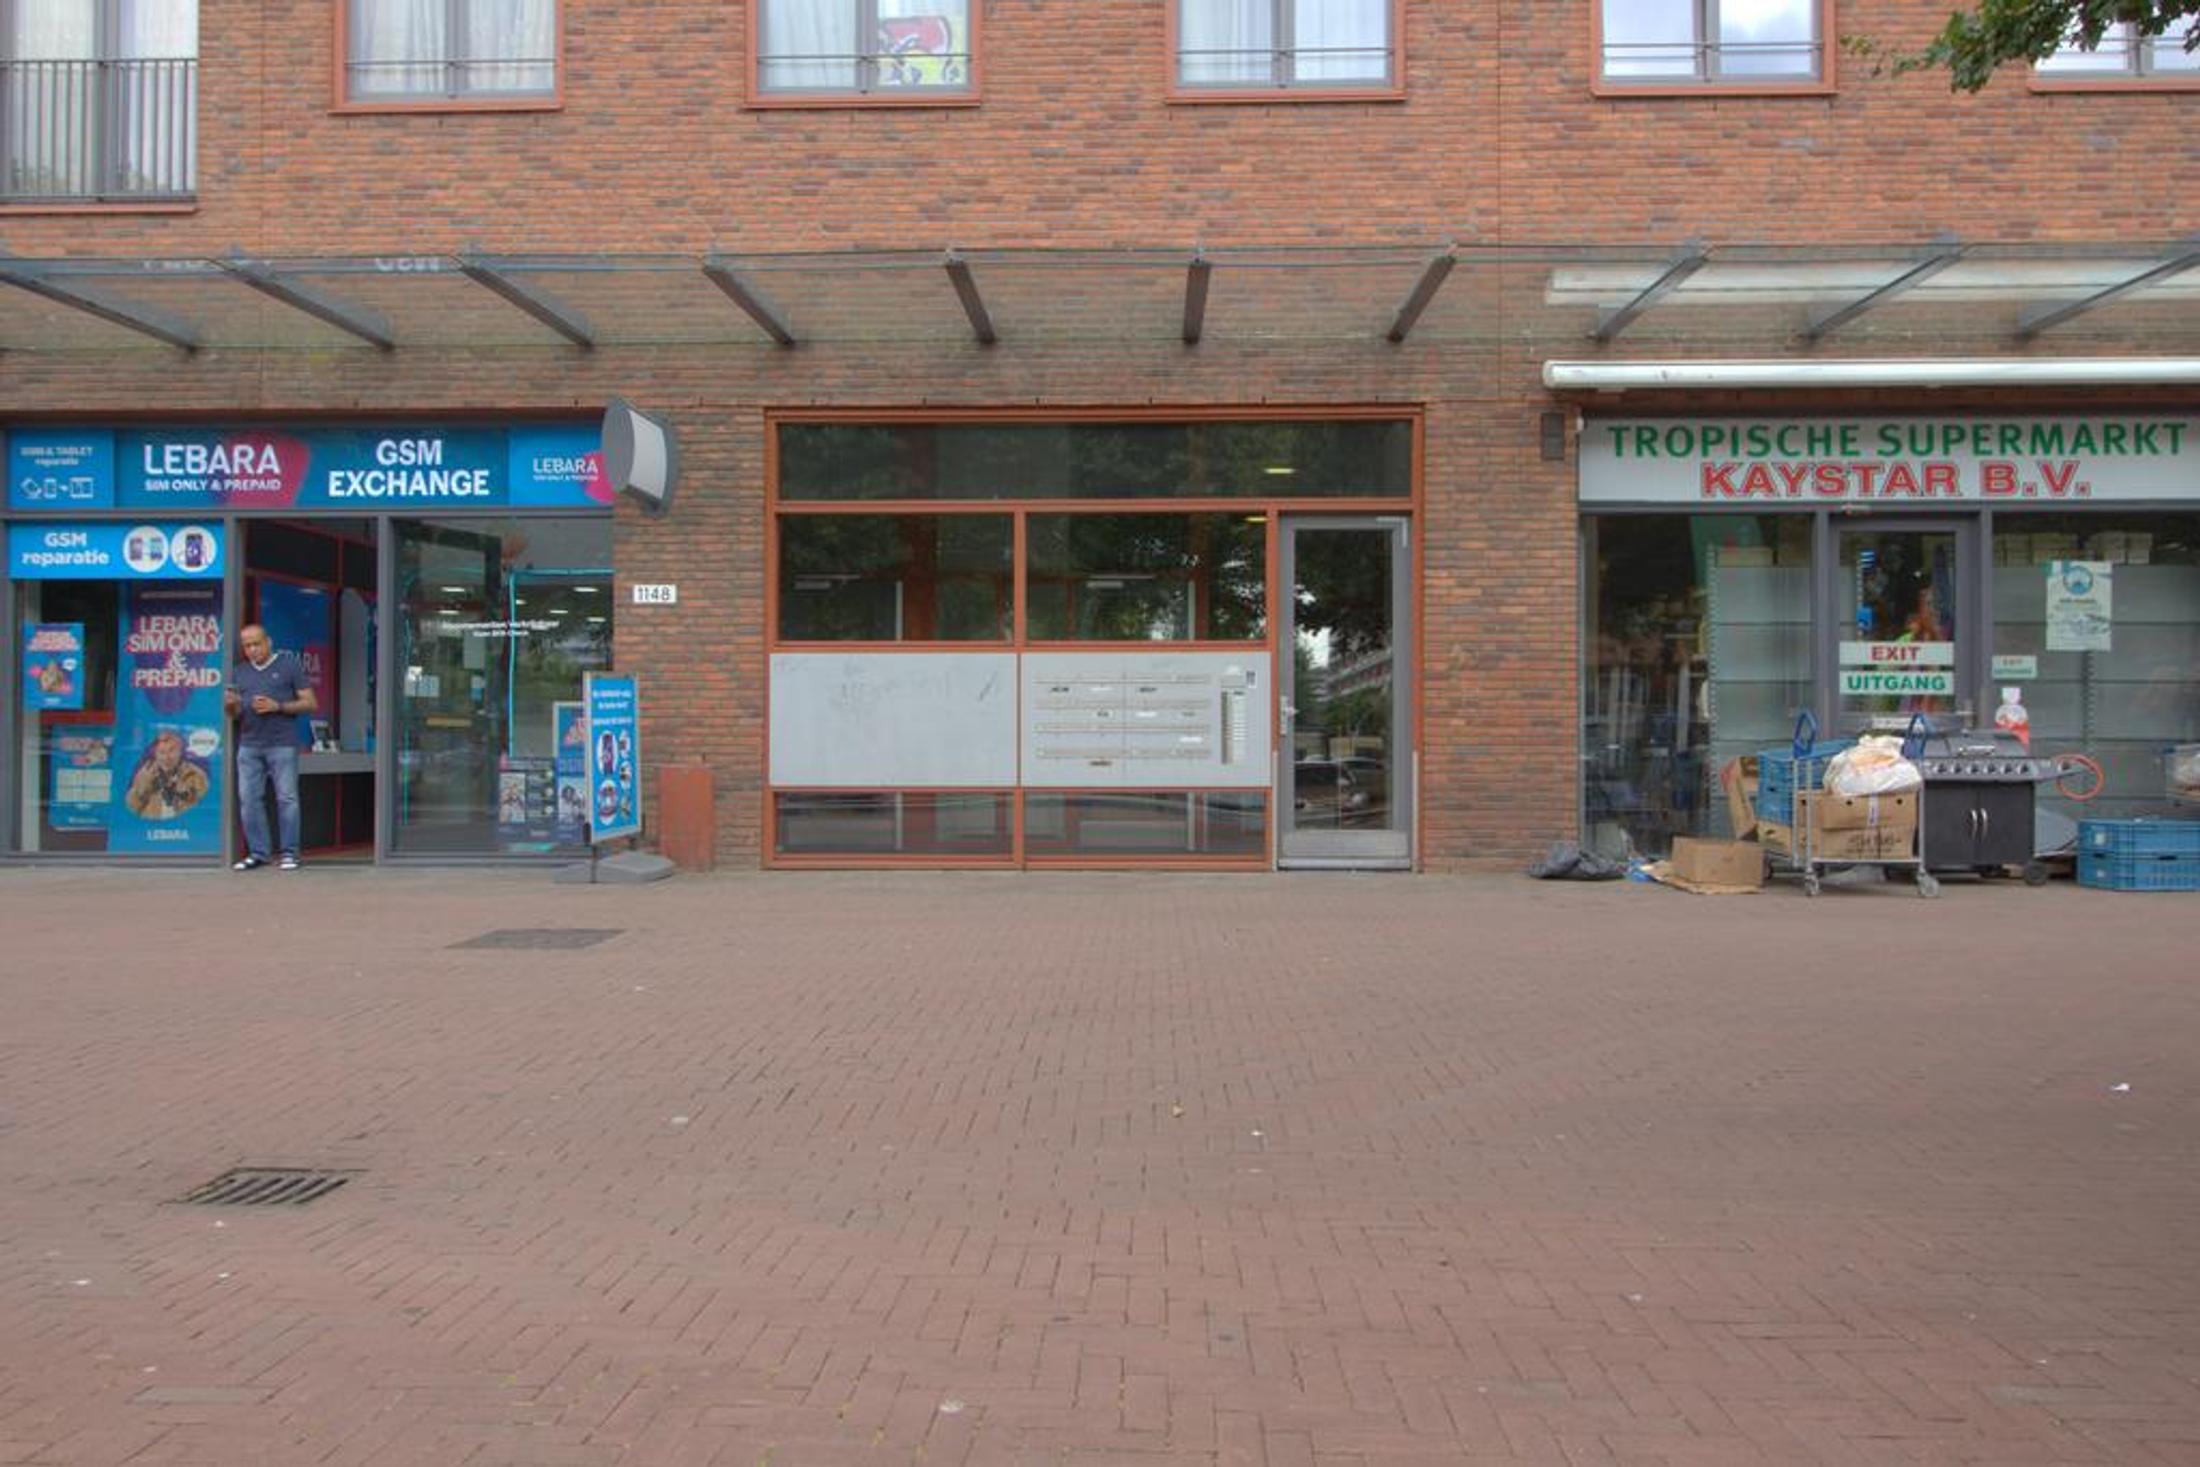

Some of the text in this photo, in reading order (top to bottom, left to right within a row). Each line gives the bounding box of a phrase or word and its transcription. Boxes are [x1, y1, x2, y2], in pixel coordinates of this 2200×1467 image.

[1609, 422, 2187, 458] TROPISCHE SUPERMARKT
[143, 444, 281, 475] LEBARA
[376, 438, 442, 466] GSM
[533, 458, 598, 474] LEBARA
[145, 481, 170, 491] SIM
[172, 481, 206, 491] ONLY
[223, 481, 281, 491] PREPAID
[328, 470, 490, 497] EXCHANGE
[1700, 461, 2092, 498] KAYSTAR B.V.
[44, 533, 87, 548] GSM
[21, 551, 110, 567] reparatie
[638, 587, 671, 601] 1148
[139, 615, 219, 634] LEBARA
[128, 633, 222, 653] SIM ONLY
[1871, 647, 1921, 660] EXIT
[135, 668, 221, 687] PREPAID
[1847, 675, 1946, 691] UITGANG
